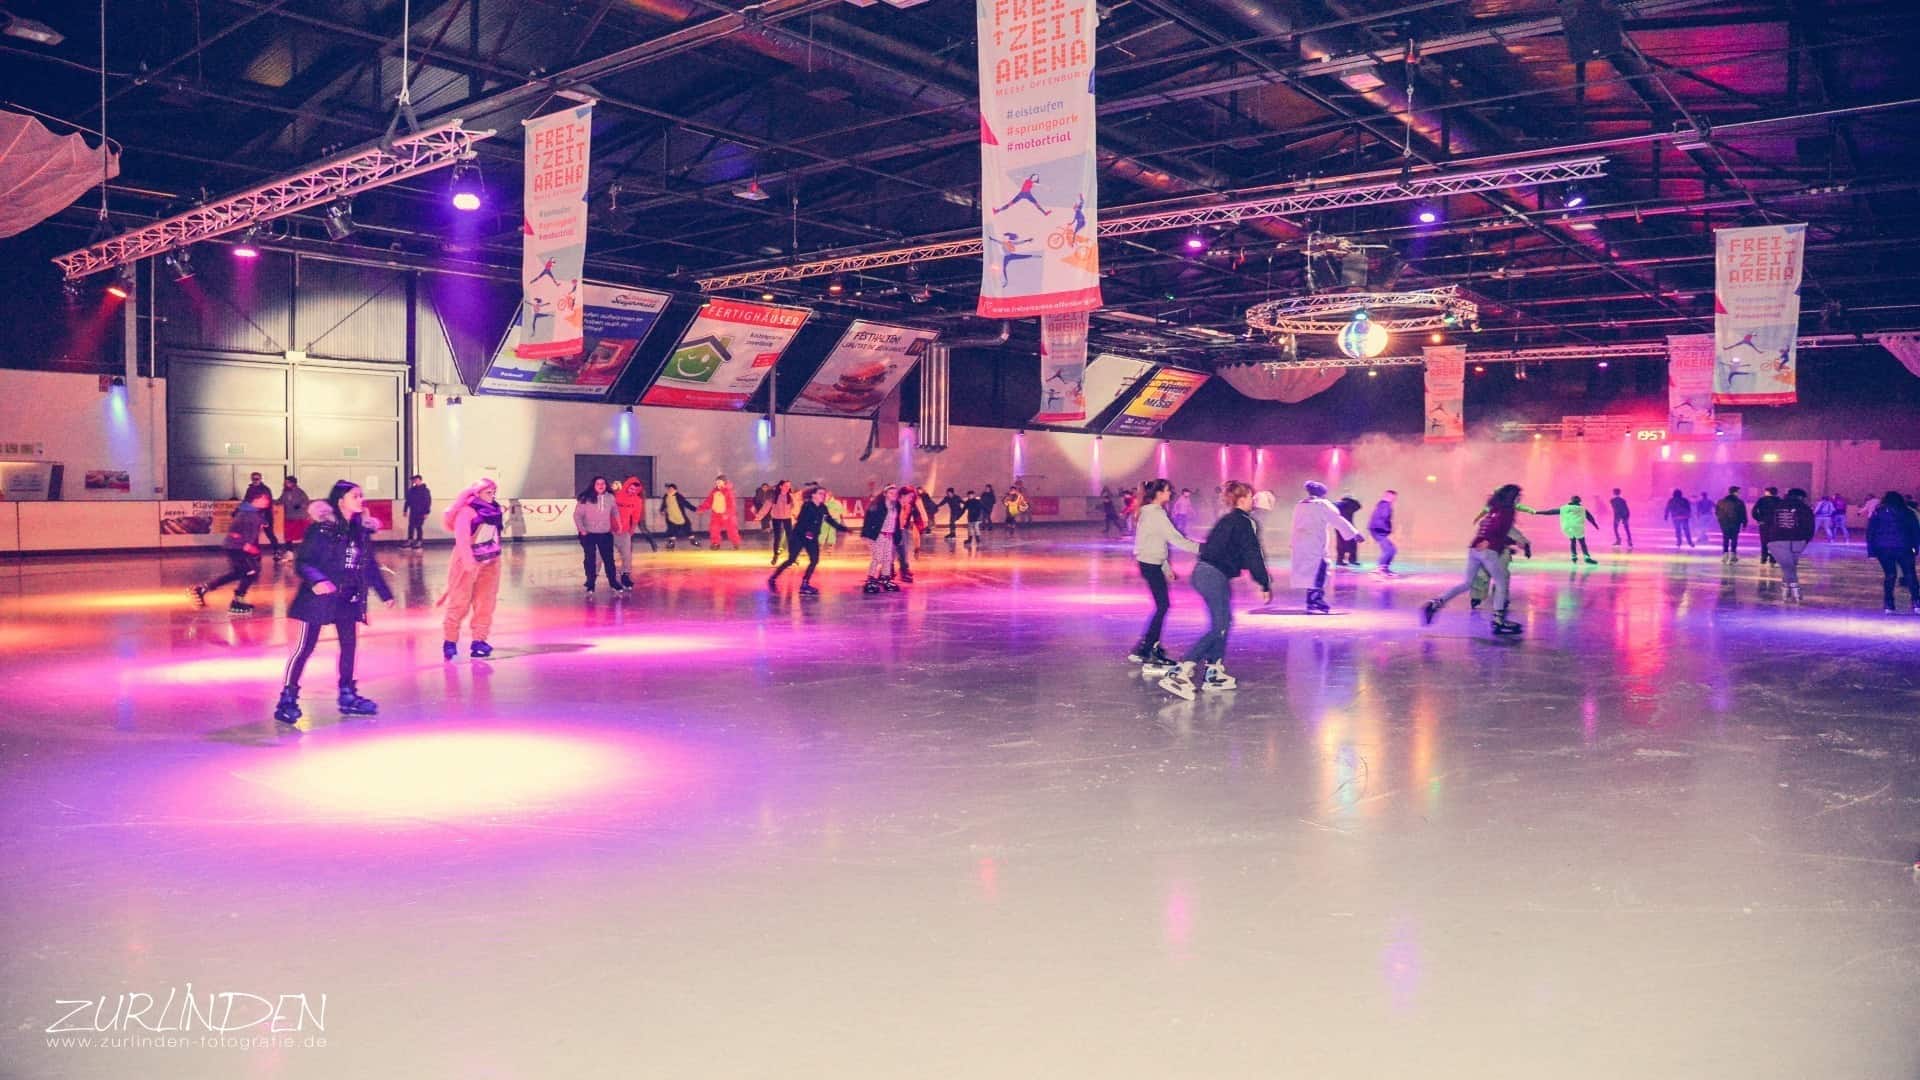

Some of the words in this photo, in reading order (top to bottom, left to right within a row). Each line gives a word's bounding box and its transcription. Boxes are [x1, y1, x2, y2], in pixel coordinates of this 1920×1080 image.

[995, 39, 1088, 85] ARENA
[994, 85, 1025, 97] MESSE
[1006, 100, 1064, 119] #eislaufen
[1006, 113, 1079, 137] #sprungpark
[1006, 131, 1072, 152] #motortrial
[534, 165, 584, 193] ARENA
[1729, 266, 1794, 282] ARENA
[707, 305, 800, 325] FERTIGHÄUSER
